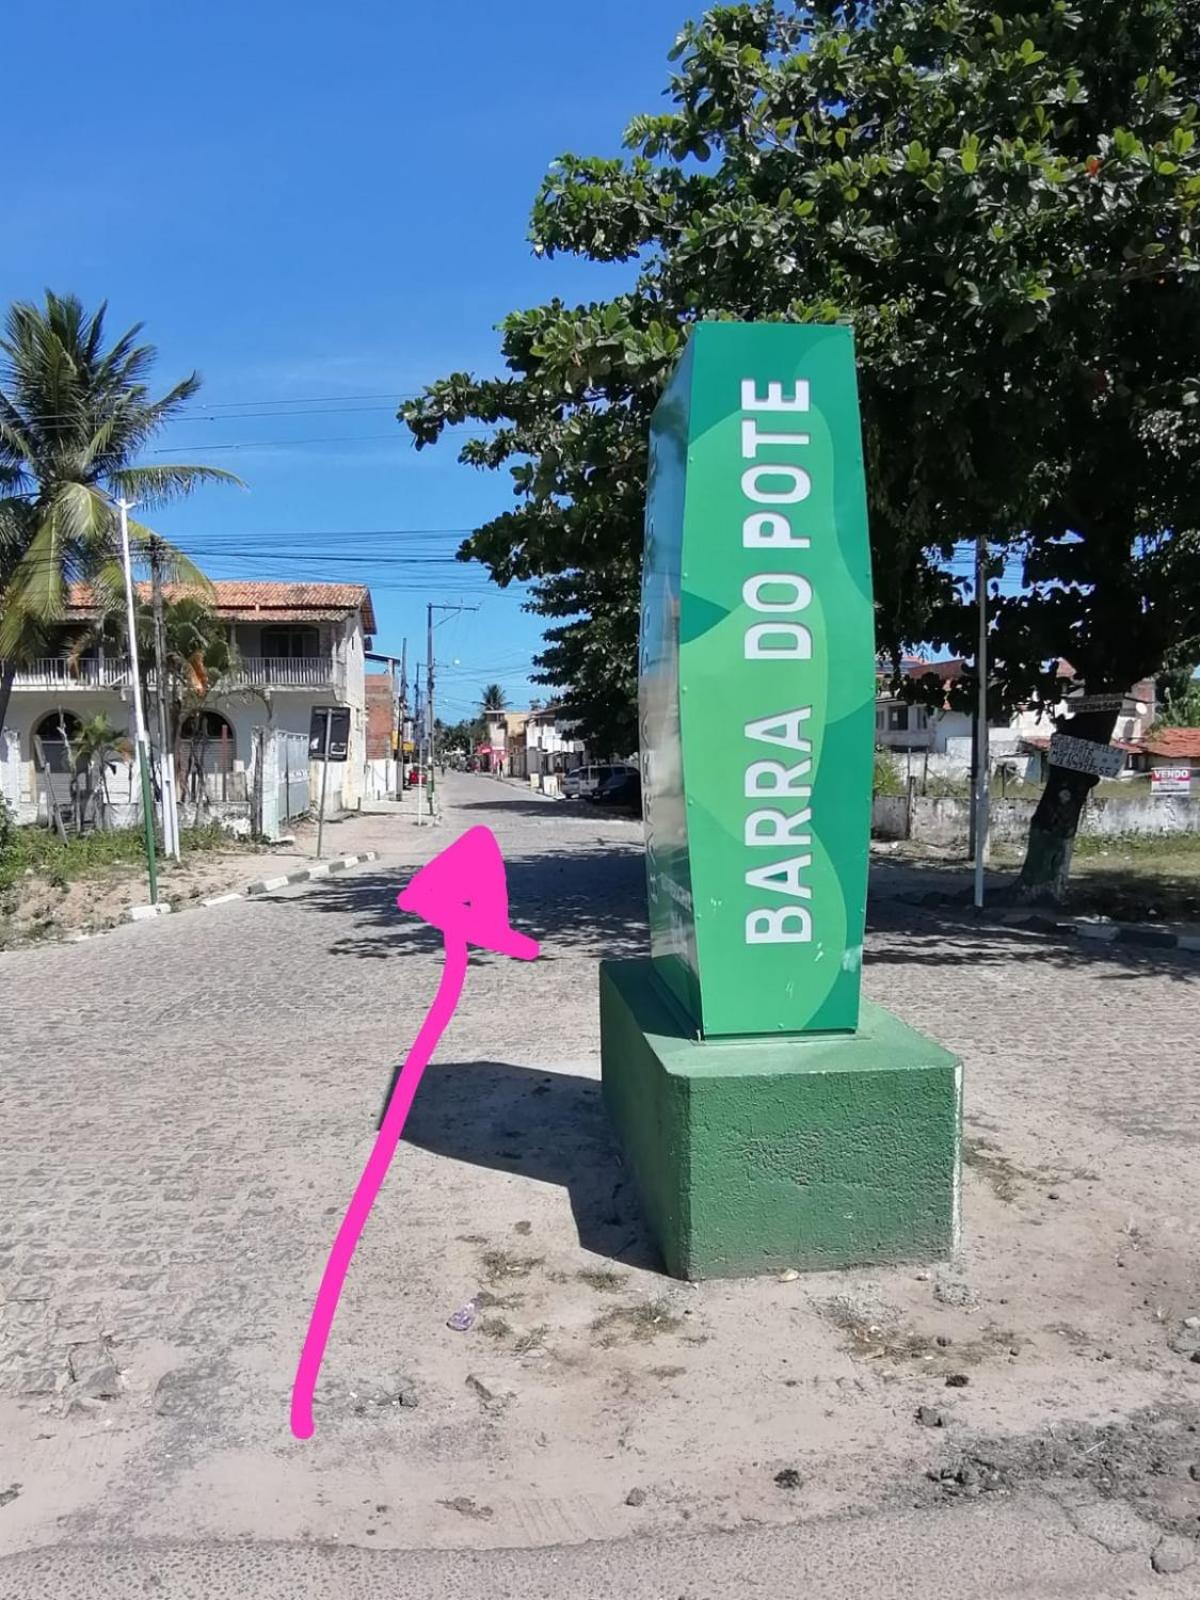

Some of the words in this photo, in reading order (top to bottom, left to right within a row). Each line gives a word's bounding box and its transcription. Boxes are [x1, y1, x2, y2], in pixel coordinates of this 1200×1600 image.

[741, 379, 812, 549] POTE
[743, 574, 813, 660] DO
[744, 704, 812, 944] BARRA
[1153, 769, 1188, 779] VENDO
